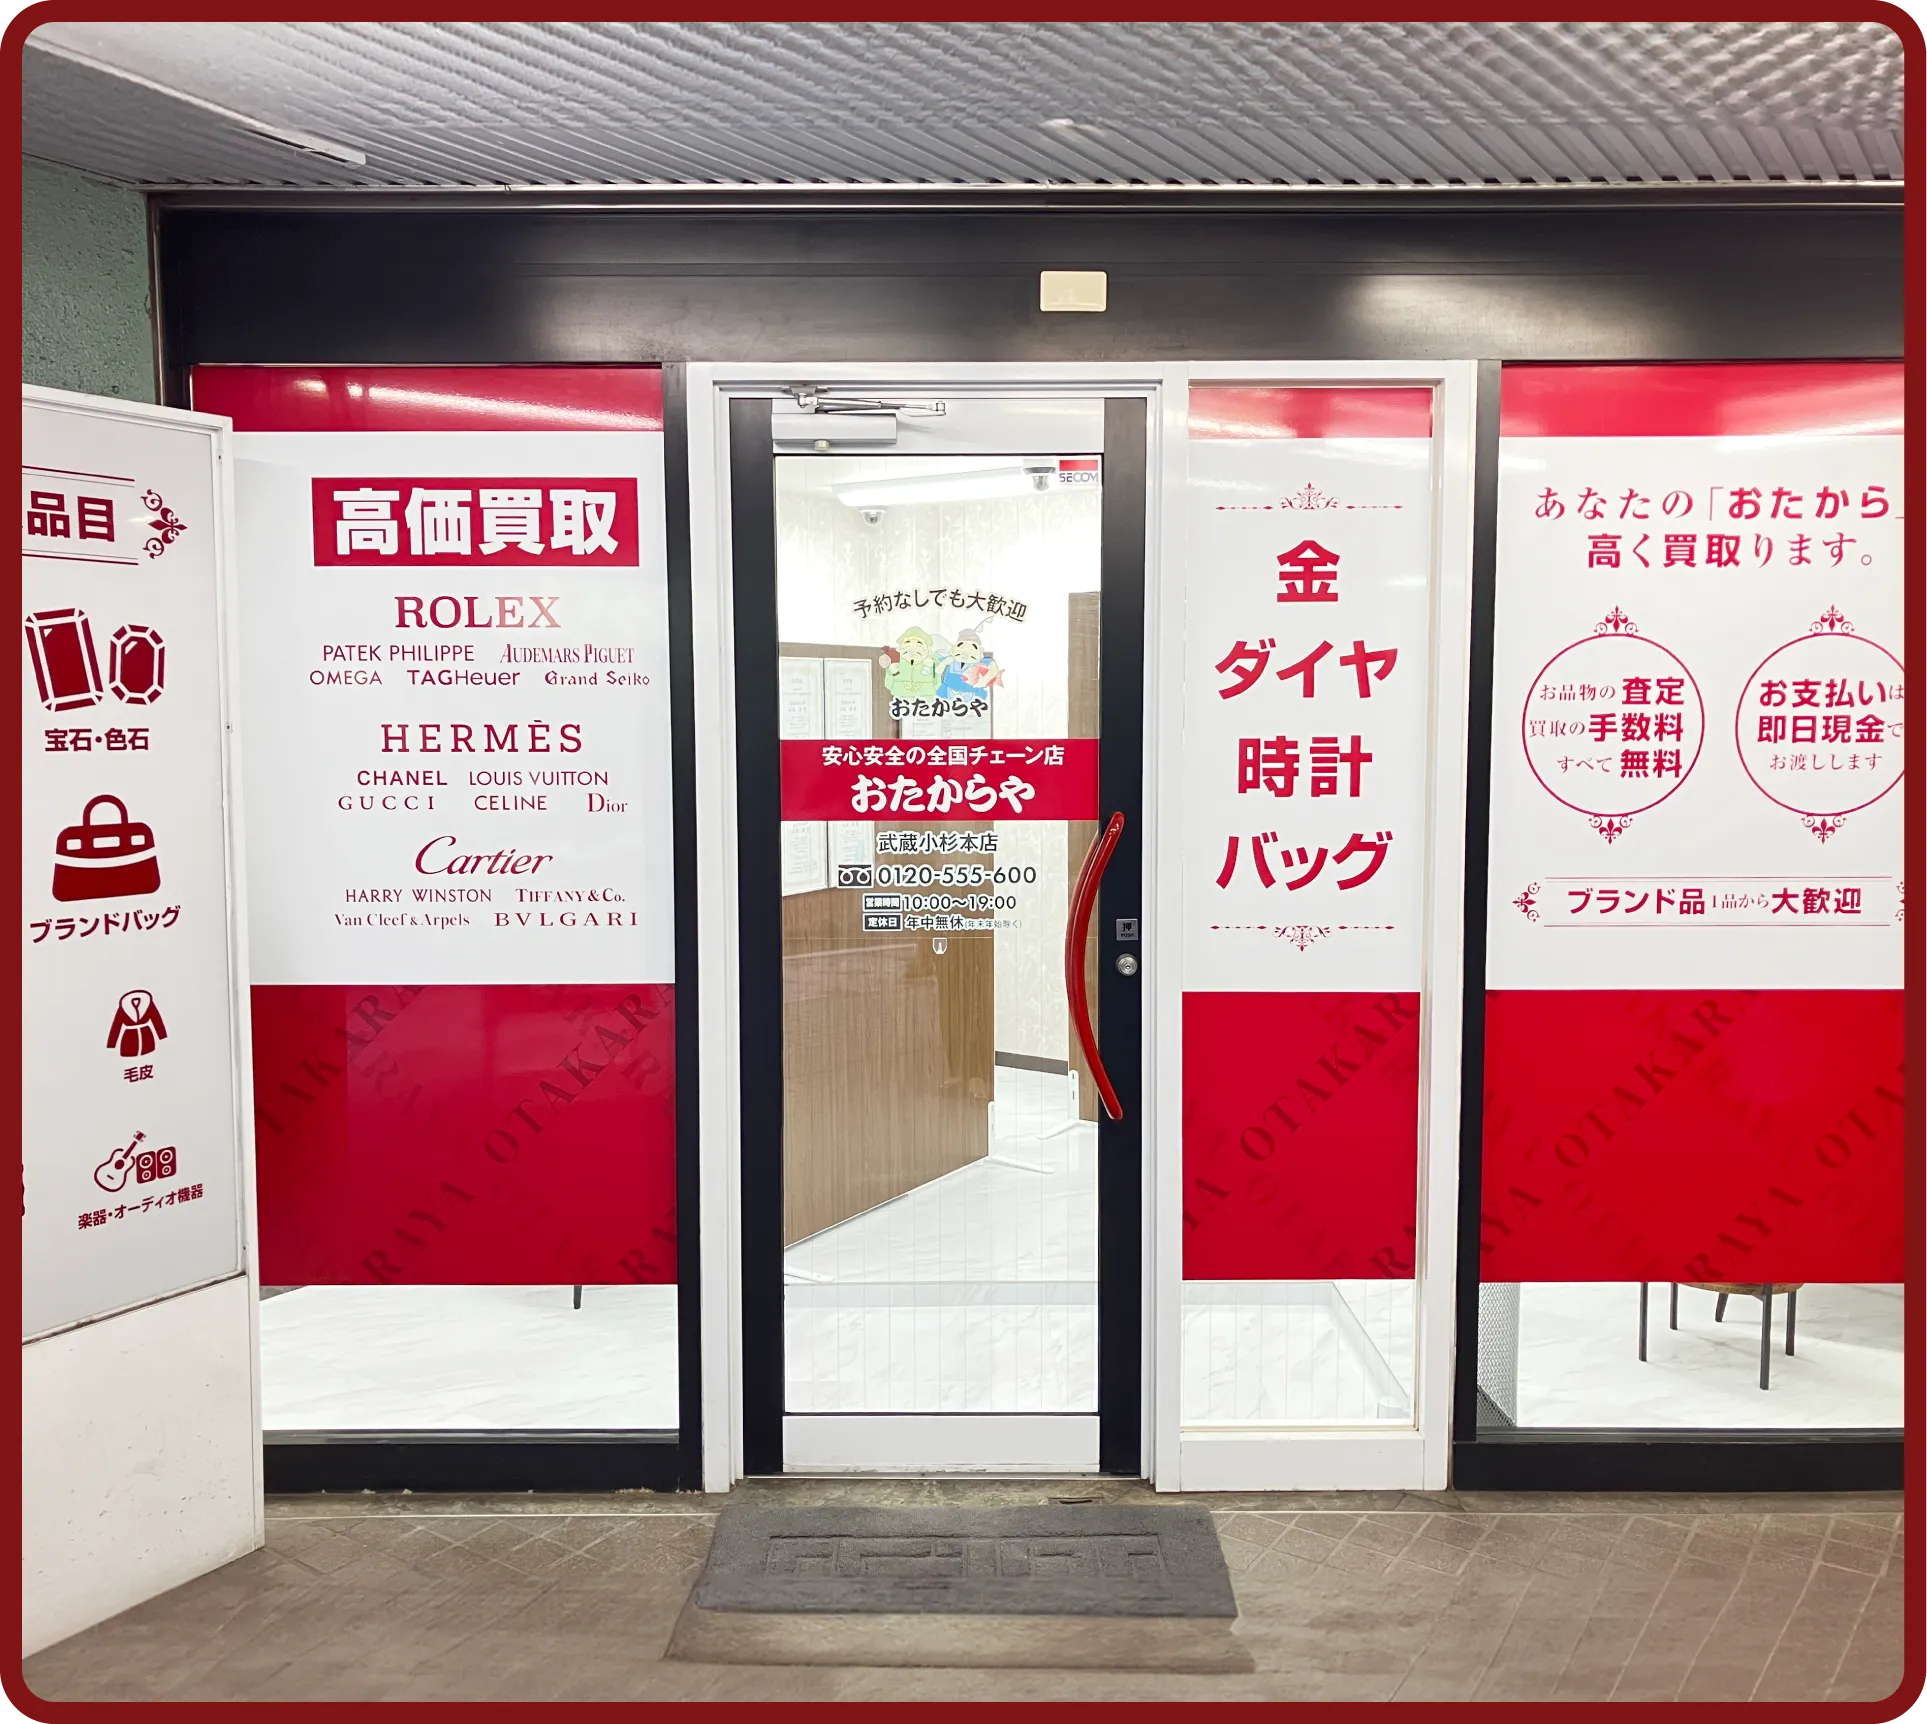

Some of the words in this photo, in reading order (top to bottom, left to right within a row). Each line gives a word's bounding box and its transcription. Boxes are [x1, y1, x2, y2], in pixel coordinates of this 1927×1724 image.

[1059, 472, 1098, 482] SECOM
[27, 491, 115, 542] 品目
[334, 488, 618, 554] 高価買取
[1588, 532, 1873, 568] 高く買取ります。
[1276, 540, 1341, 602] 金
[394, 596, 561, 628] ROLEX
[853, 588, 1027, 622] 予約なしでも大歓迎
[324, 645, 382, 661] PATEK
[390, 645, 474, 661] PHILIPPE
[500, 644, 580, 663] AUDEMARS
[584, 644, 634, 663] PIGUET
[310, 670, 382, 685] OMEGA
[545, 670, 597, 685] Grand
[606, 670, 649, 685] Seiko
[1214, 638, 1399, 700] ダイヤ
[891, 698, 988, 717] おたからや
[45, 728, 149, 752] 宝石・色石
[381, 720, 581, 753] HERMÈS
[821, 744, 1064, 766] 安心安全の全国チェーン店
[1770, 753, 1882, 771] お渡しします
[1238, 735, 1373, 798] 時計
[357, 770, 447, 786] CHANEL
[470, 771, 522, 785] LOUIS
[529, 771, 608, 785] VUITTON
[338, 796, 434, 810] GUCCI
[475, 795, 547, 810] CELINE
[588, 793, 628, 812] Dior
[850, 774, 1035, 813] おたからや
[878, 833, 998, 852] 武蔵小杉本店
[415, 836, 553, 874] Cartier
[1215, 831, 1394, 891] バッグ
[878, 866, 1037, 884] 0120-555-600
[346, 889, 402, 902] HARRY
[412, 889, 491, 902] WINSTON
[30, 905, 181, 943] ブランドバッグ
[335, 914, 361, 926] Van
[367, 913, 407, 926] Cleef
[494, 912, 637, 926] BVLGARI
[867, 917, 897, 928] 定休日
[124, 1065, 153, 1083] 毛皮
